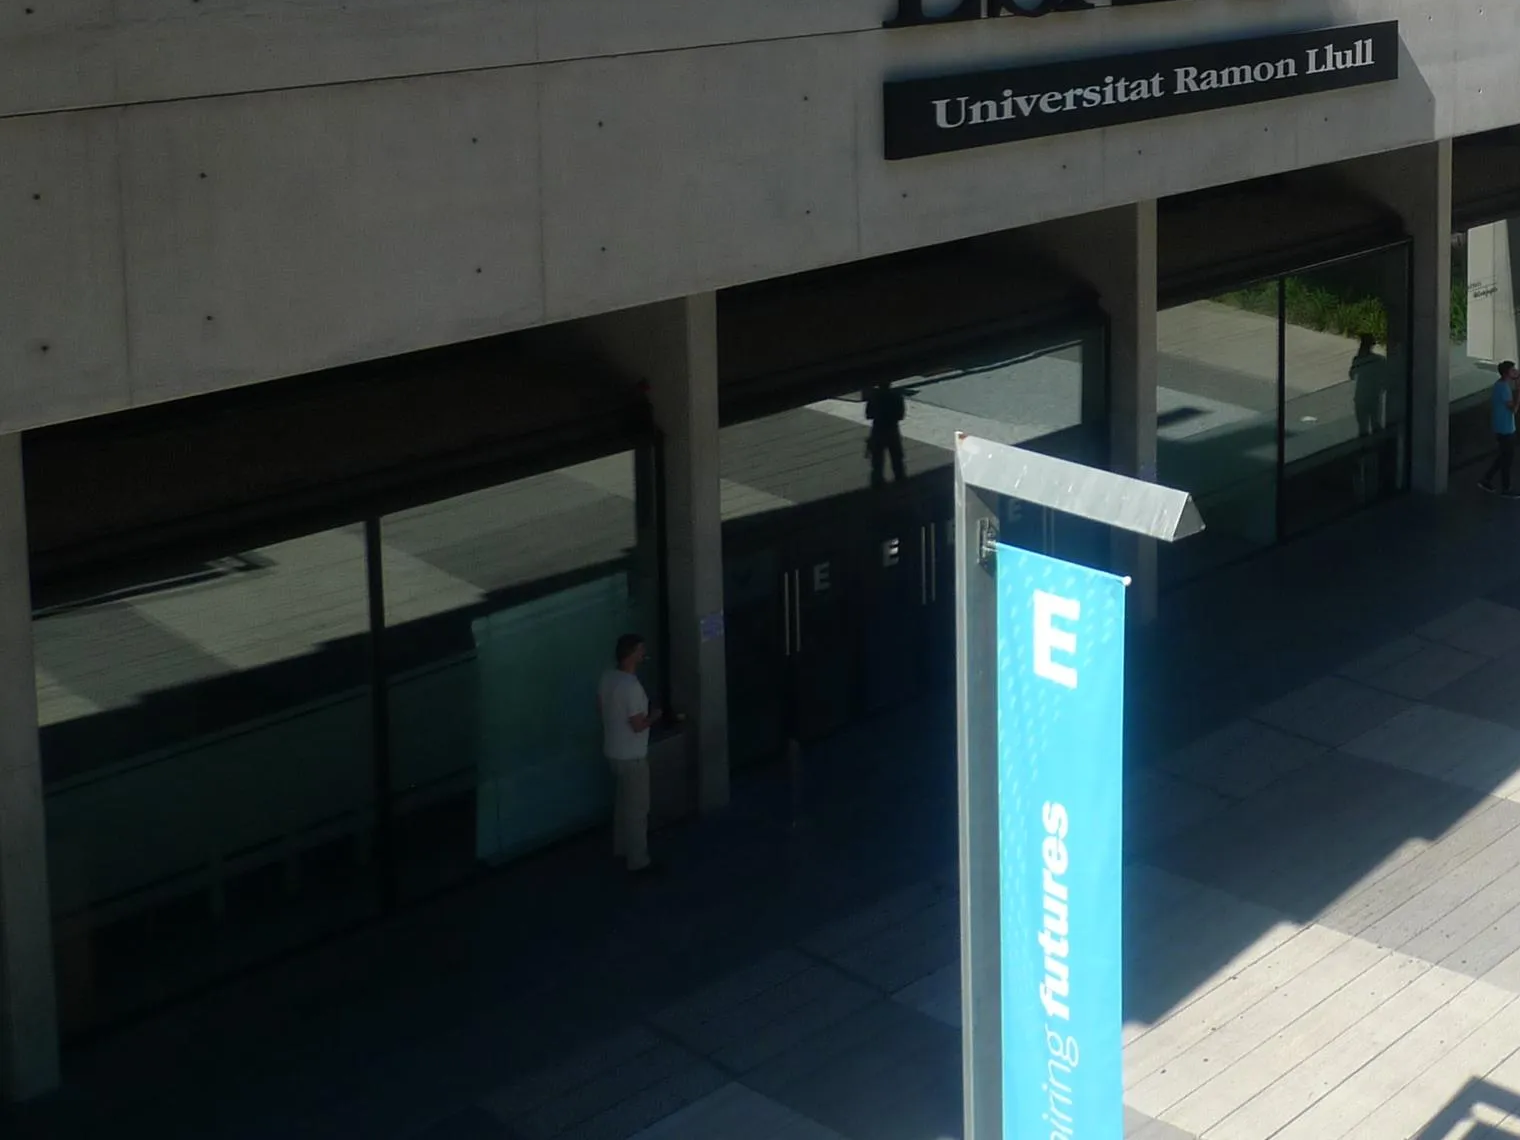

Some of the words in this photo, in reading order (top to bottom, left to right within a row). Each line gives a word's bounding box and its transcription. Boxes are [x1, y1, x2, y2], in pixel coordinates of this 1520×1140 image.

[932, 73, 1164, 129] Universitat
[1174, 58, 1297, 95] Ramon
[1305, 38, 1375, 75] Llull
[813, 561, 832, 592] E
[881, 537, 900, 568] E
[1032, 588, 1081, 690] E
[1039, 800, 1071, 1021] futures
